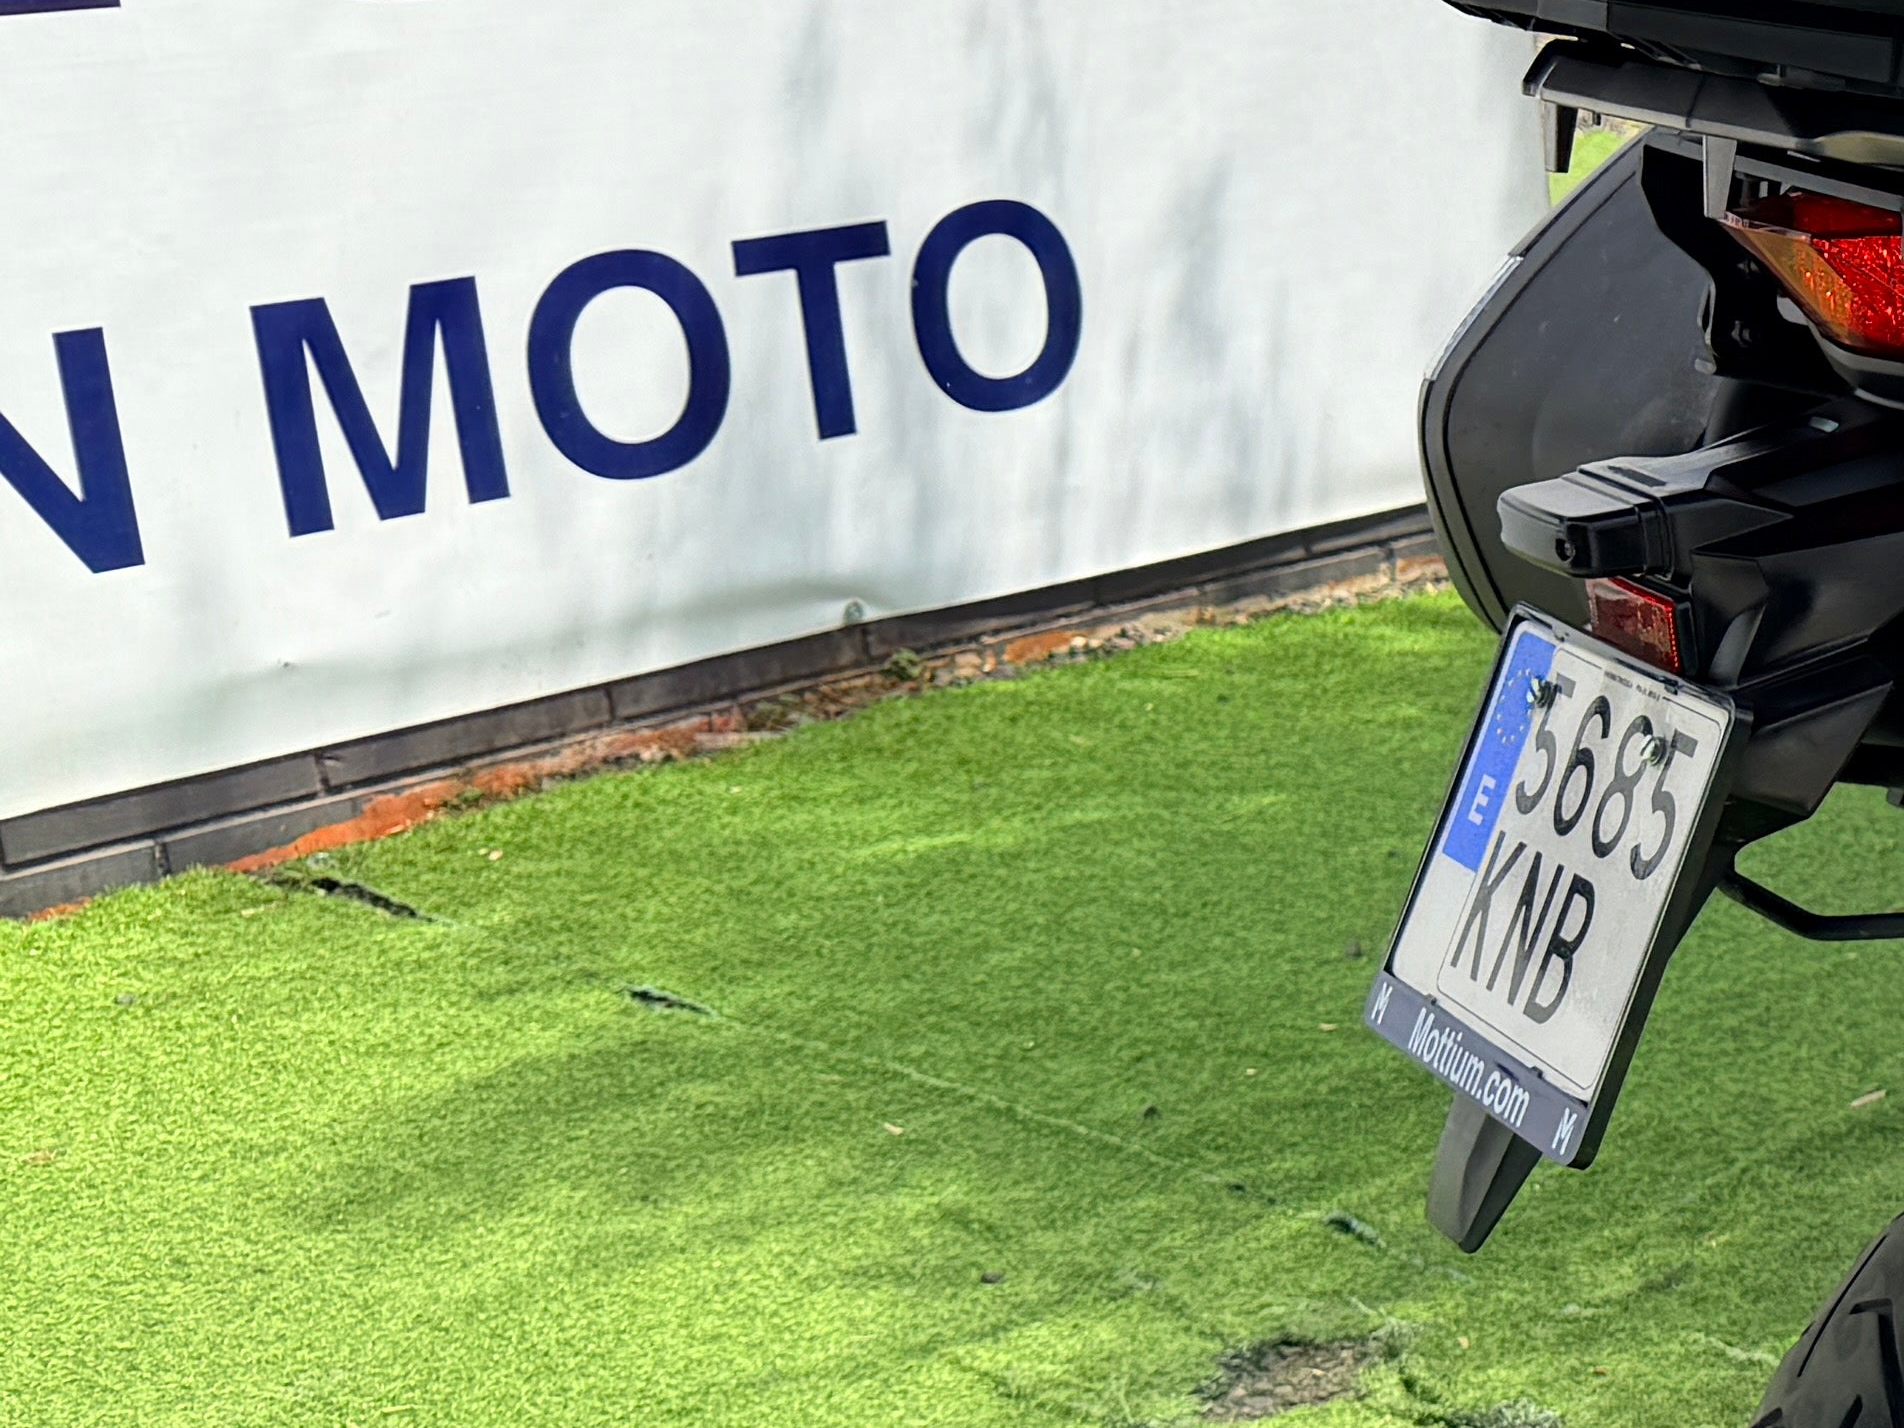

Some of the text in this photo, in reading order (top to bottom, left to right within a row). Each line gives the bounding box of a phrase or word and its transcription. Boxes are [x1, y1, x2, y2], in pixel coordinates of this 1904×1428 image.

[249, 198, 1082, 539] MOTO
[1468, 774, 1497, 826] E
[1450, 829, 1596, 1025] KNB
[1408, 1006, 1531, 1128] Mottium.com
